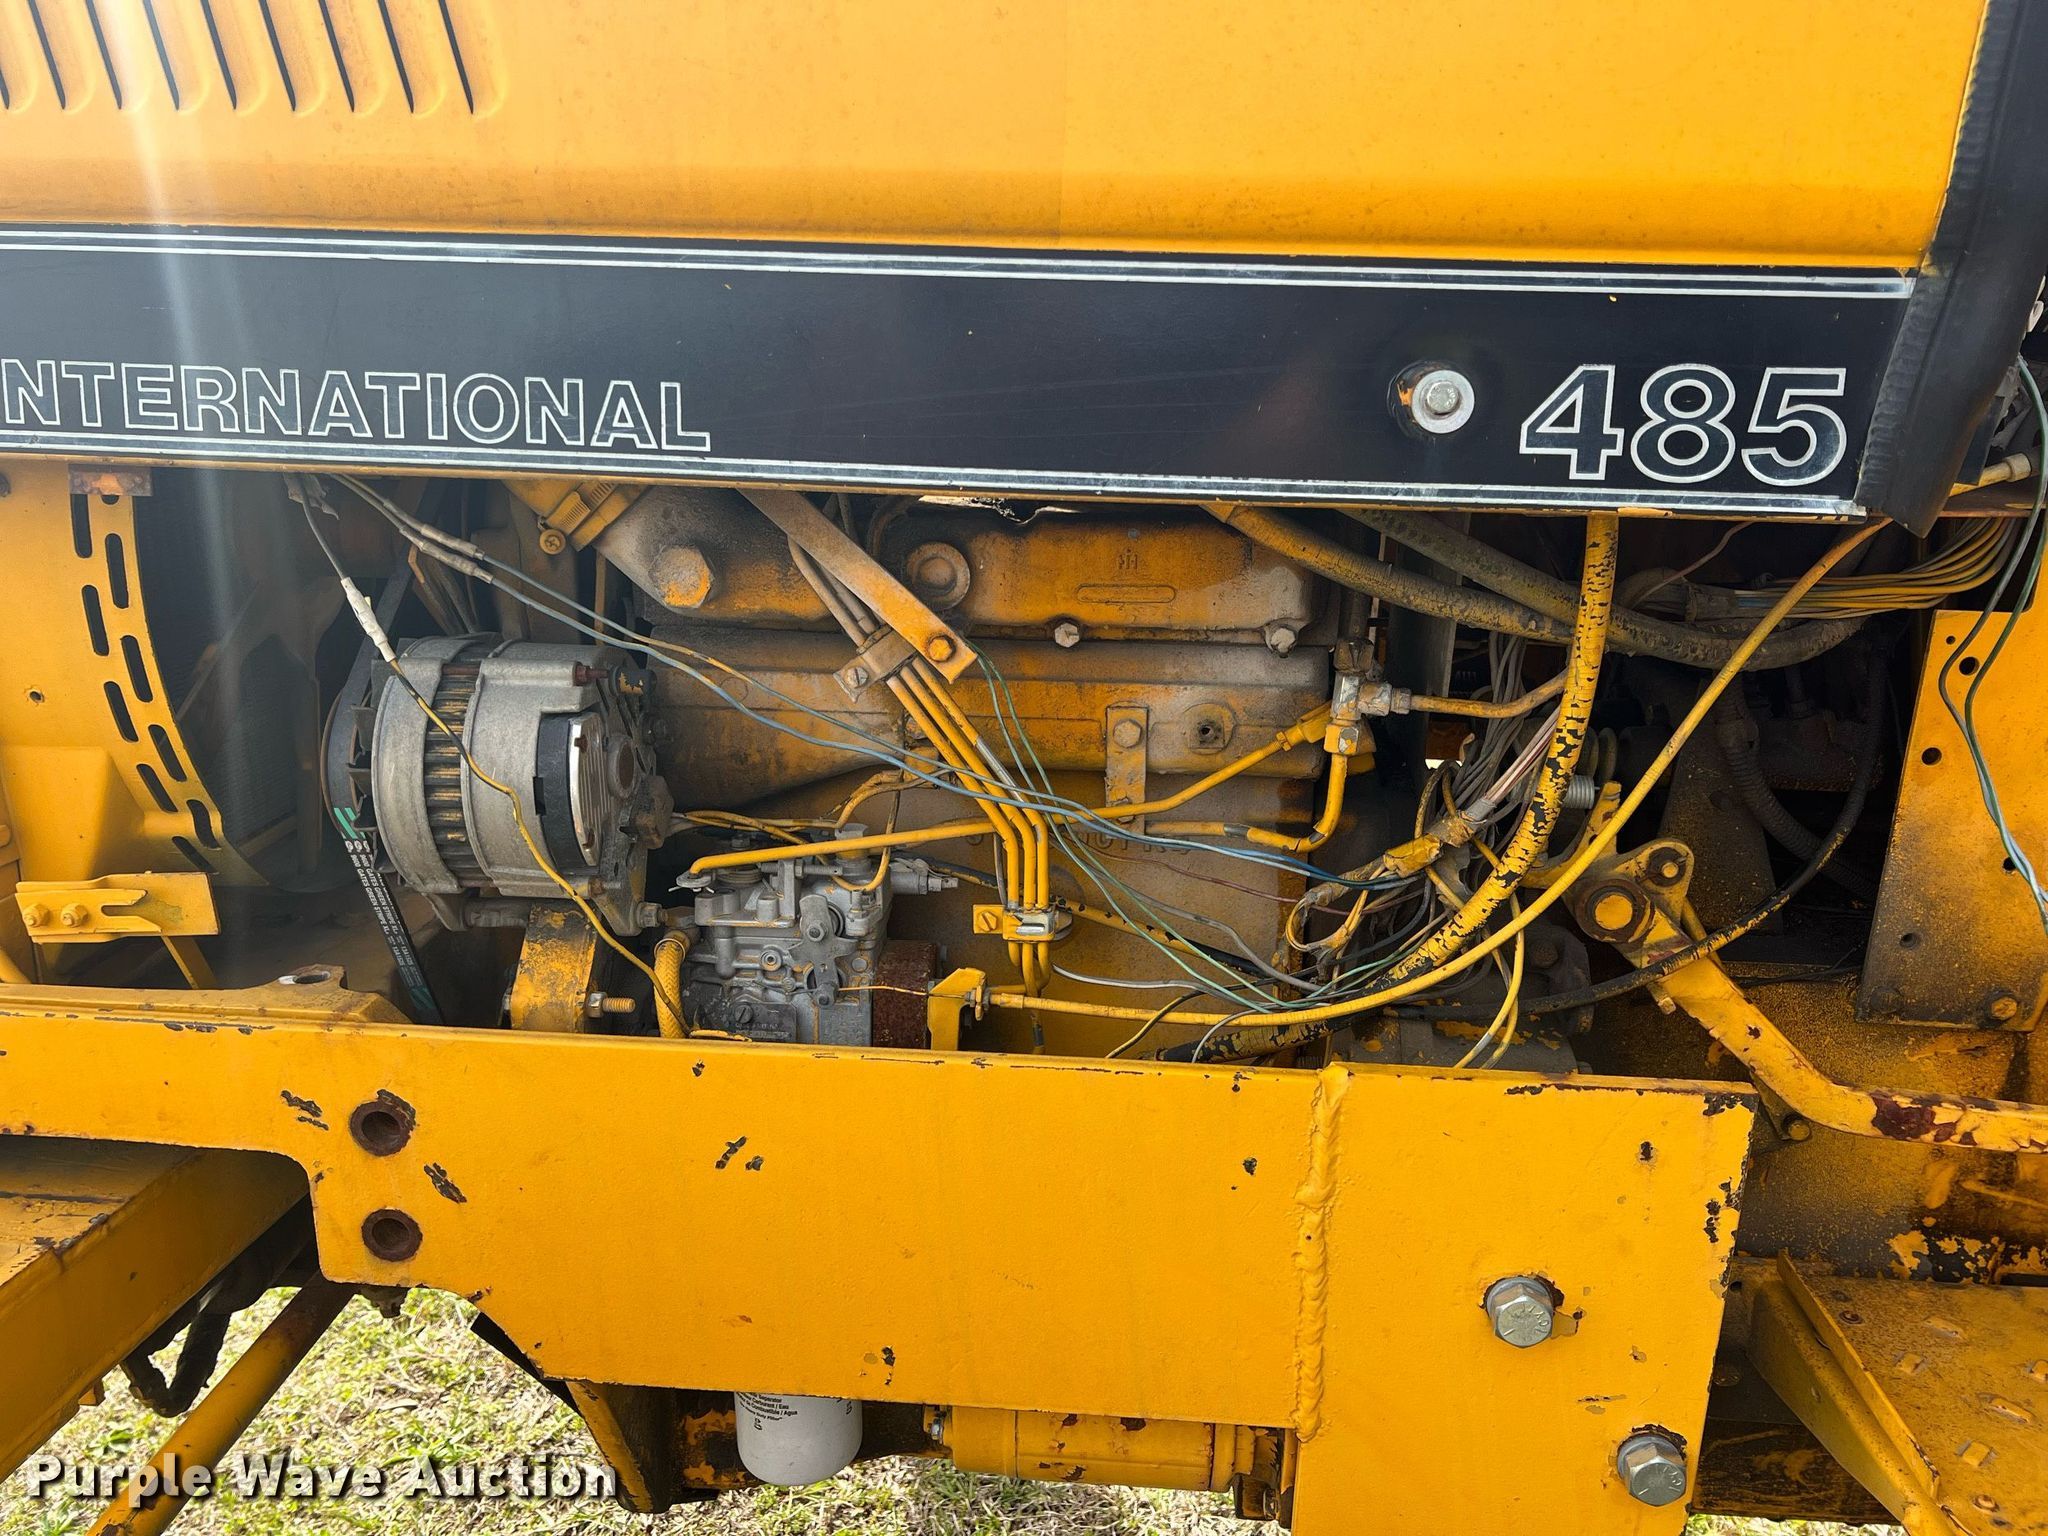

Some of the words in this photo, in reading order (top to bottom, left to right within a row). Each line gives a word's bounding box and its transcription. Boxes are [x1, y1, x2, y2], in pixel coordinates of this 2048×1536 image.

[1519, 363, 1847, 487] 485
[357, 868, 371, 887] GATES
[365, 887, 379, 906] GREEN
[374, 906, 388, 925] STRIPE
[366, 868, 379, 887] GATES
[374, 887, 388, 906] GREEN
[382, 906, 397, 925] STRIPE
